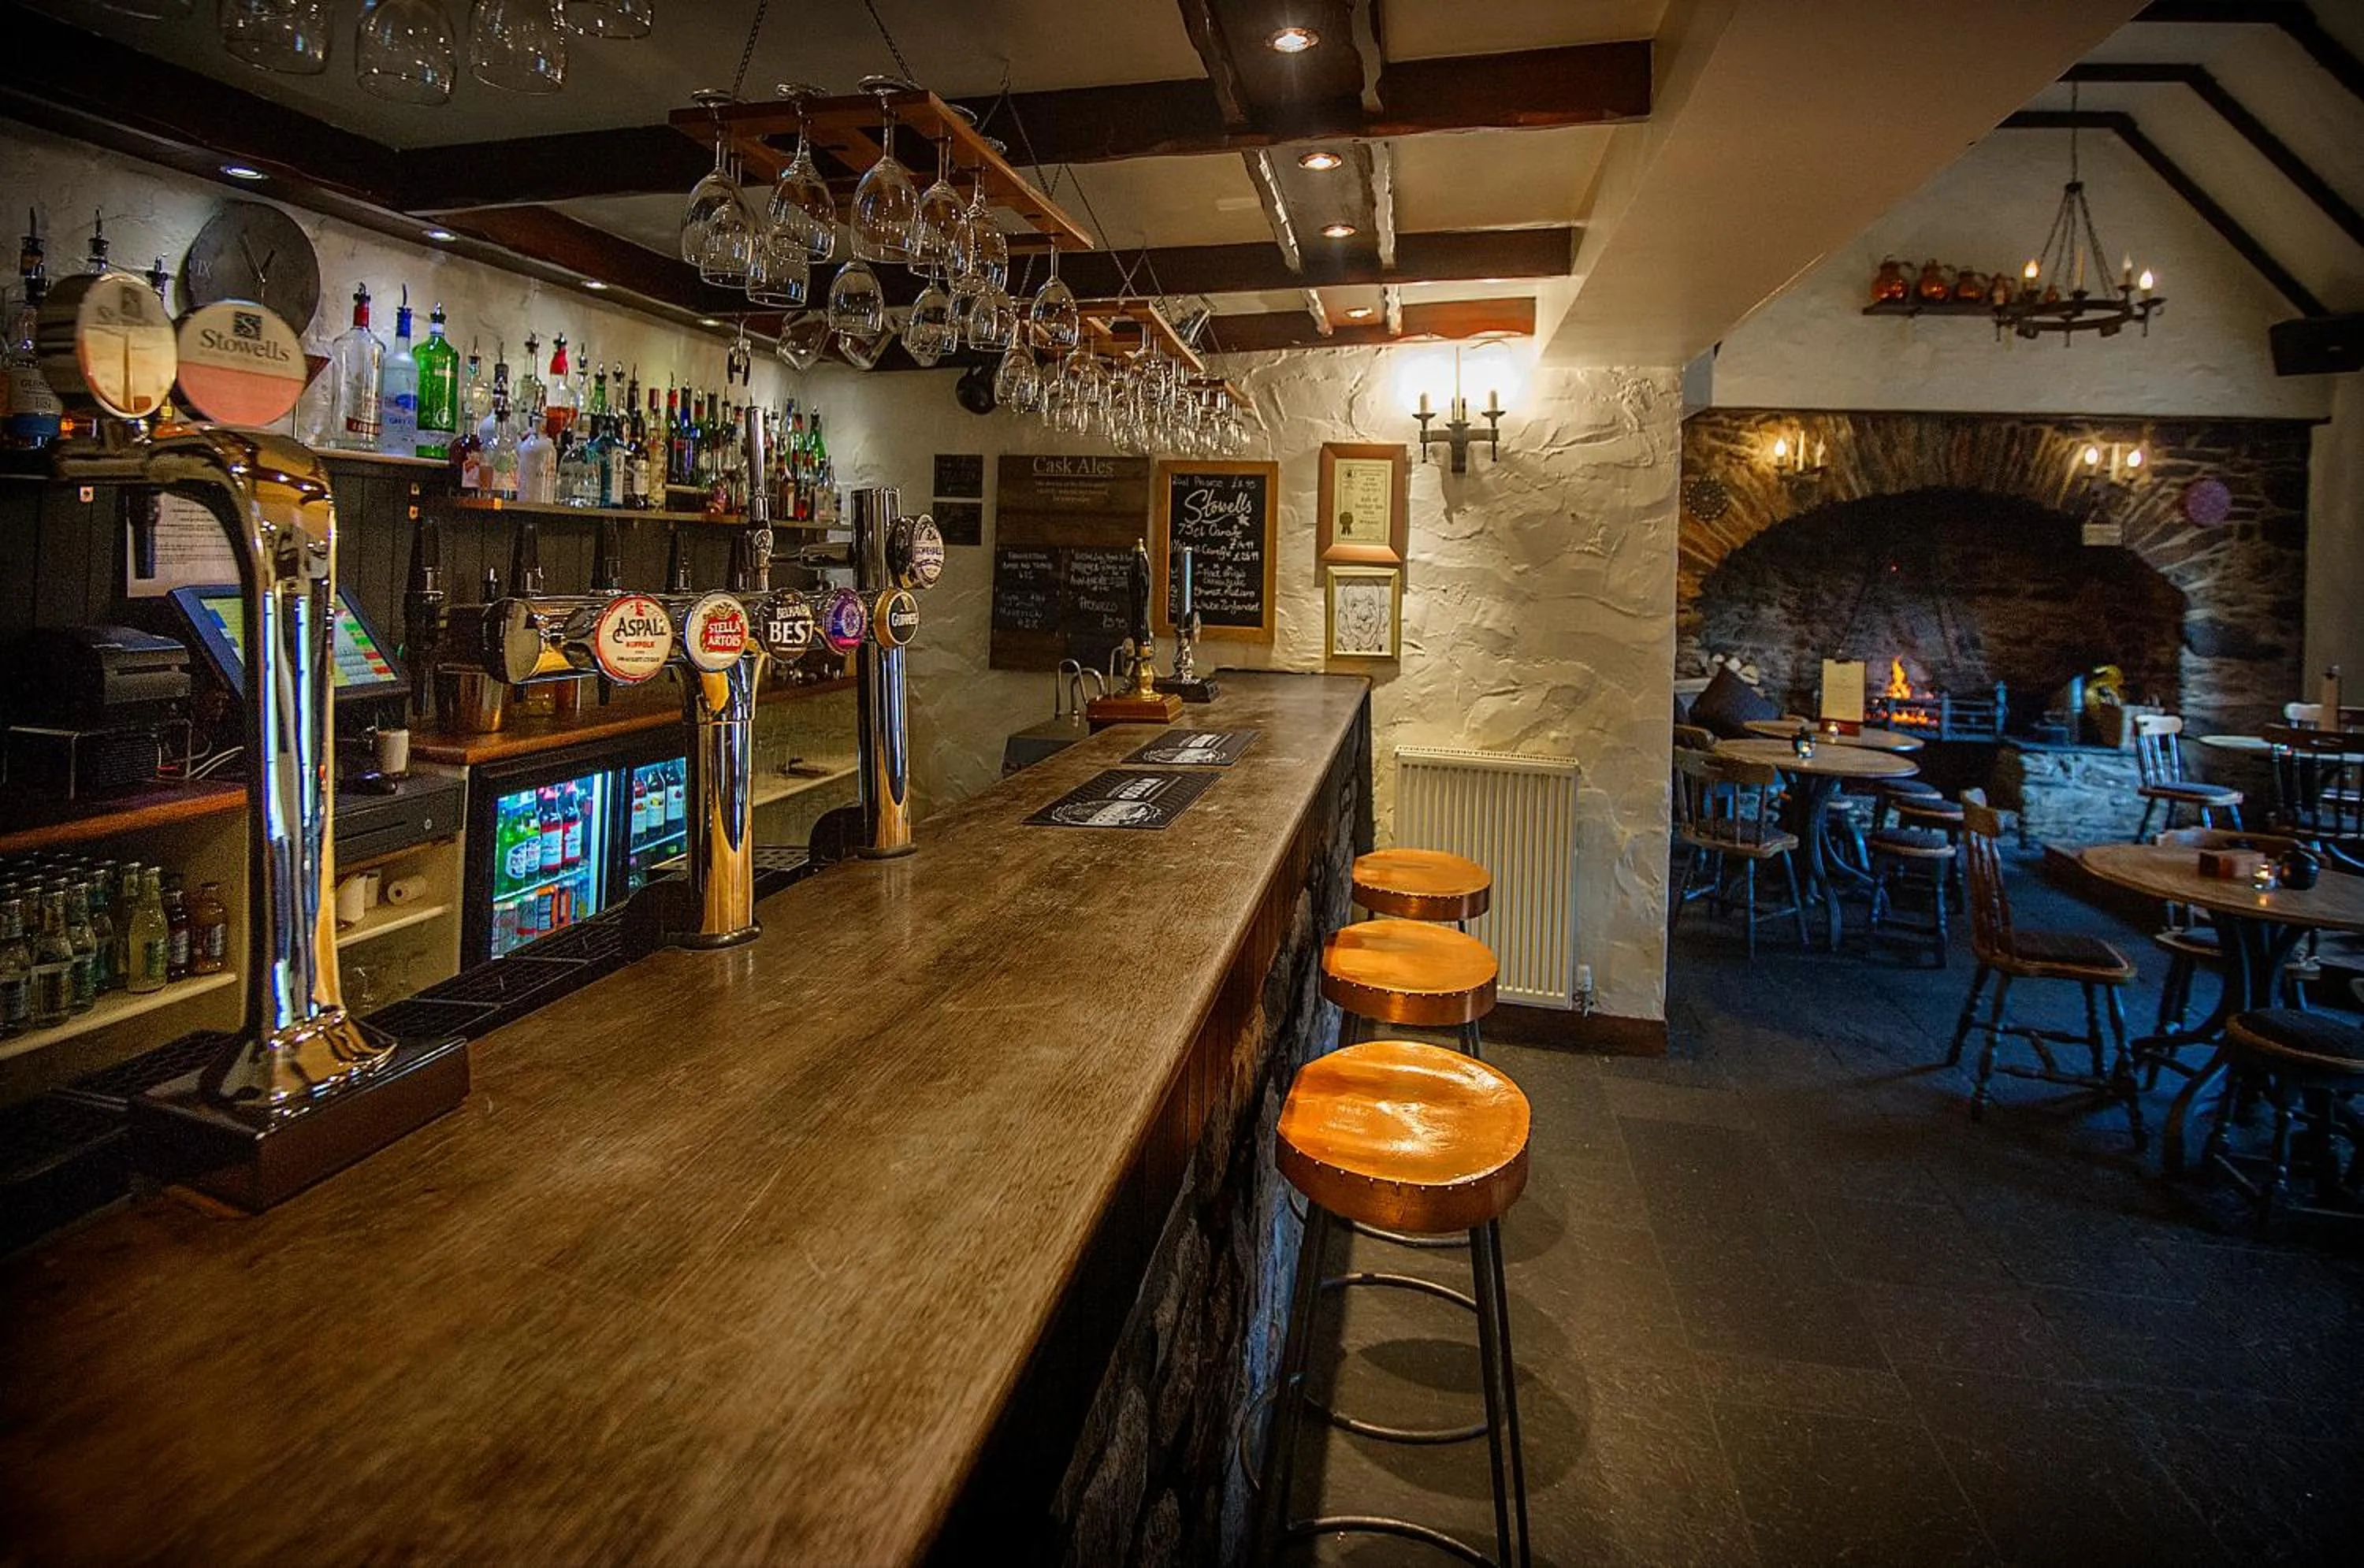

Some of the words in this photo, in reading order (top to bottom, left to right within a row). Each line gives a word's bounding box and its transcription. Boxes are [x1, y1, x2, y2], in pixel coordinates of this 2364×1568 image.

[199, 329, 291, 362] Stowells
[1033, 457, 1072, 474] Cask
[1077, 457, 1114, 474] Ales
[1184, 489, 1253, 526] Stowells
[708, 620, 742, 634] STELLA
[768, 620, 816, 645] BEST
[707, 634, 742, 647] ARTOIS
